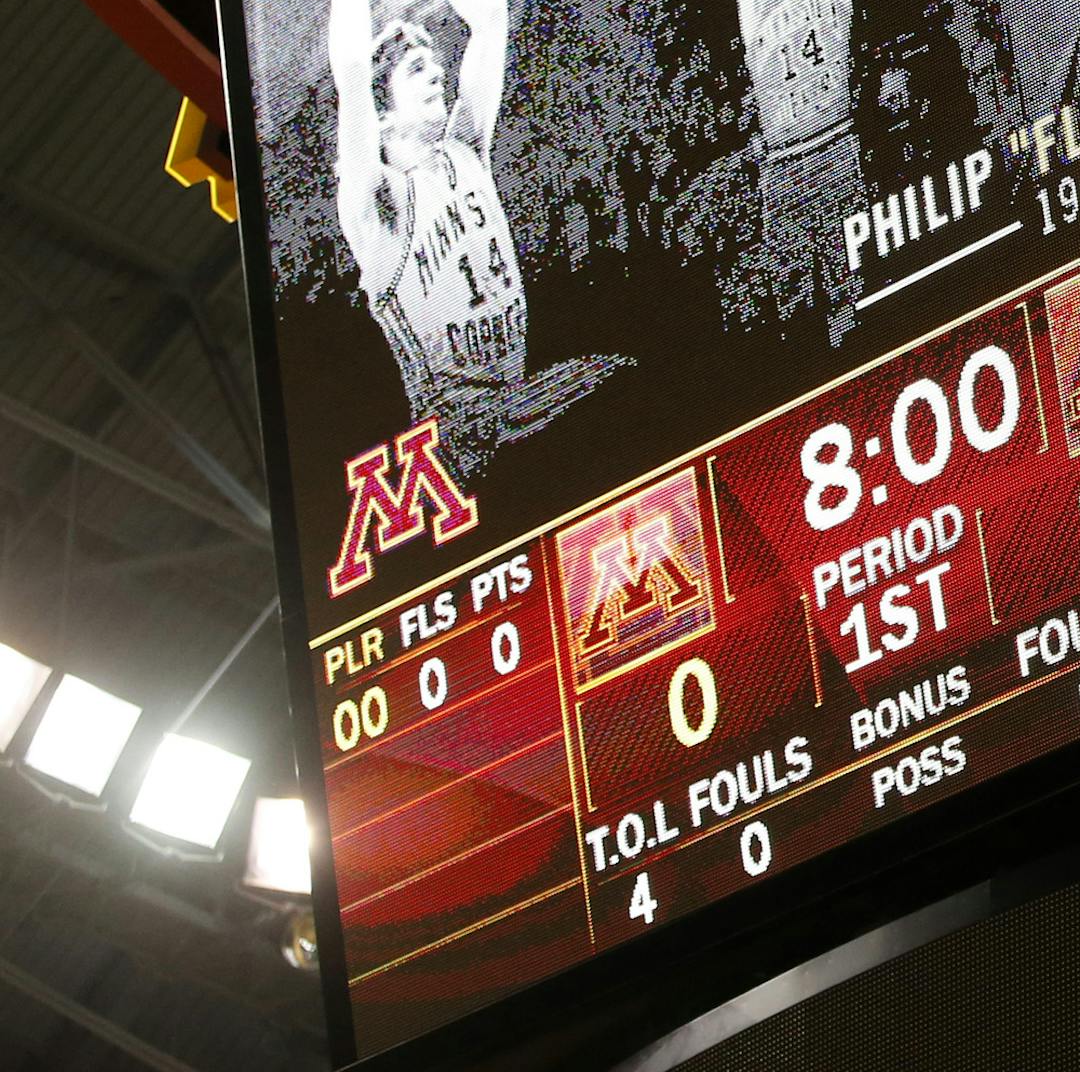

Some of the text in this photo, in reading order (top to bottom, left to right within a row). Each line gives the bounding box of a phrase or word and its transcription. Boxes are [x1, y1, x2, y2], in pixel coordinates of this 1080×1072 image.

[843, 148, 994, 272] PHILIP
[800, 344, 1020, 532] 8:00
[812, 503, 965, 611] PERIOD
[324, 554, 533, 685] PLR FLS PTS
[838, 562, 952, 674] 1ST
[332, 620, 521, 752] 00 0 0
[667, 657, 720, 748] 0
[850, 666, 971, 751] BONUS
[584, 736, 814, 872] T.O.L FOULS
[872, 735, 967, 808] POSS
[628, 820, 774, 926] 4 0
